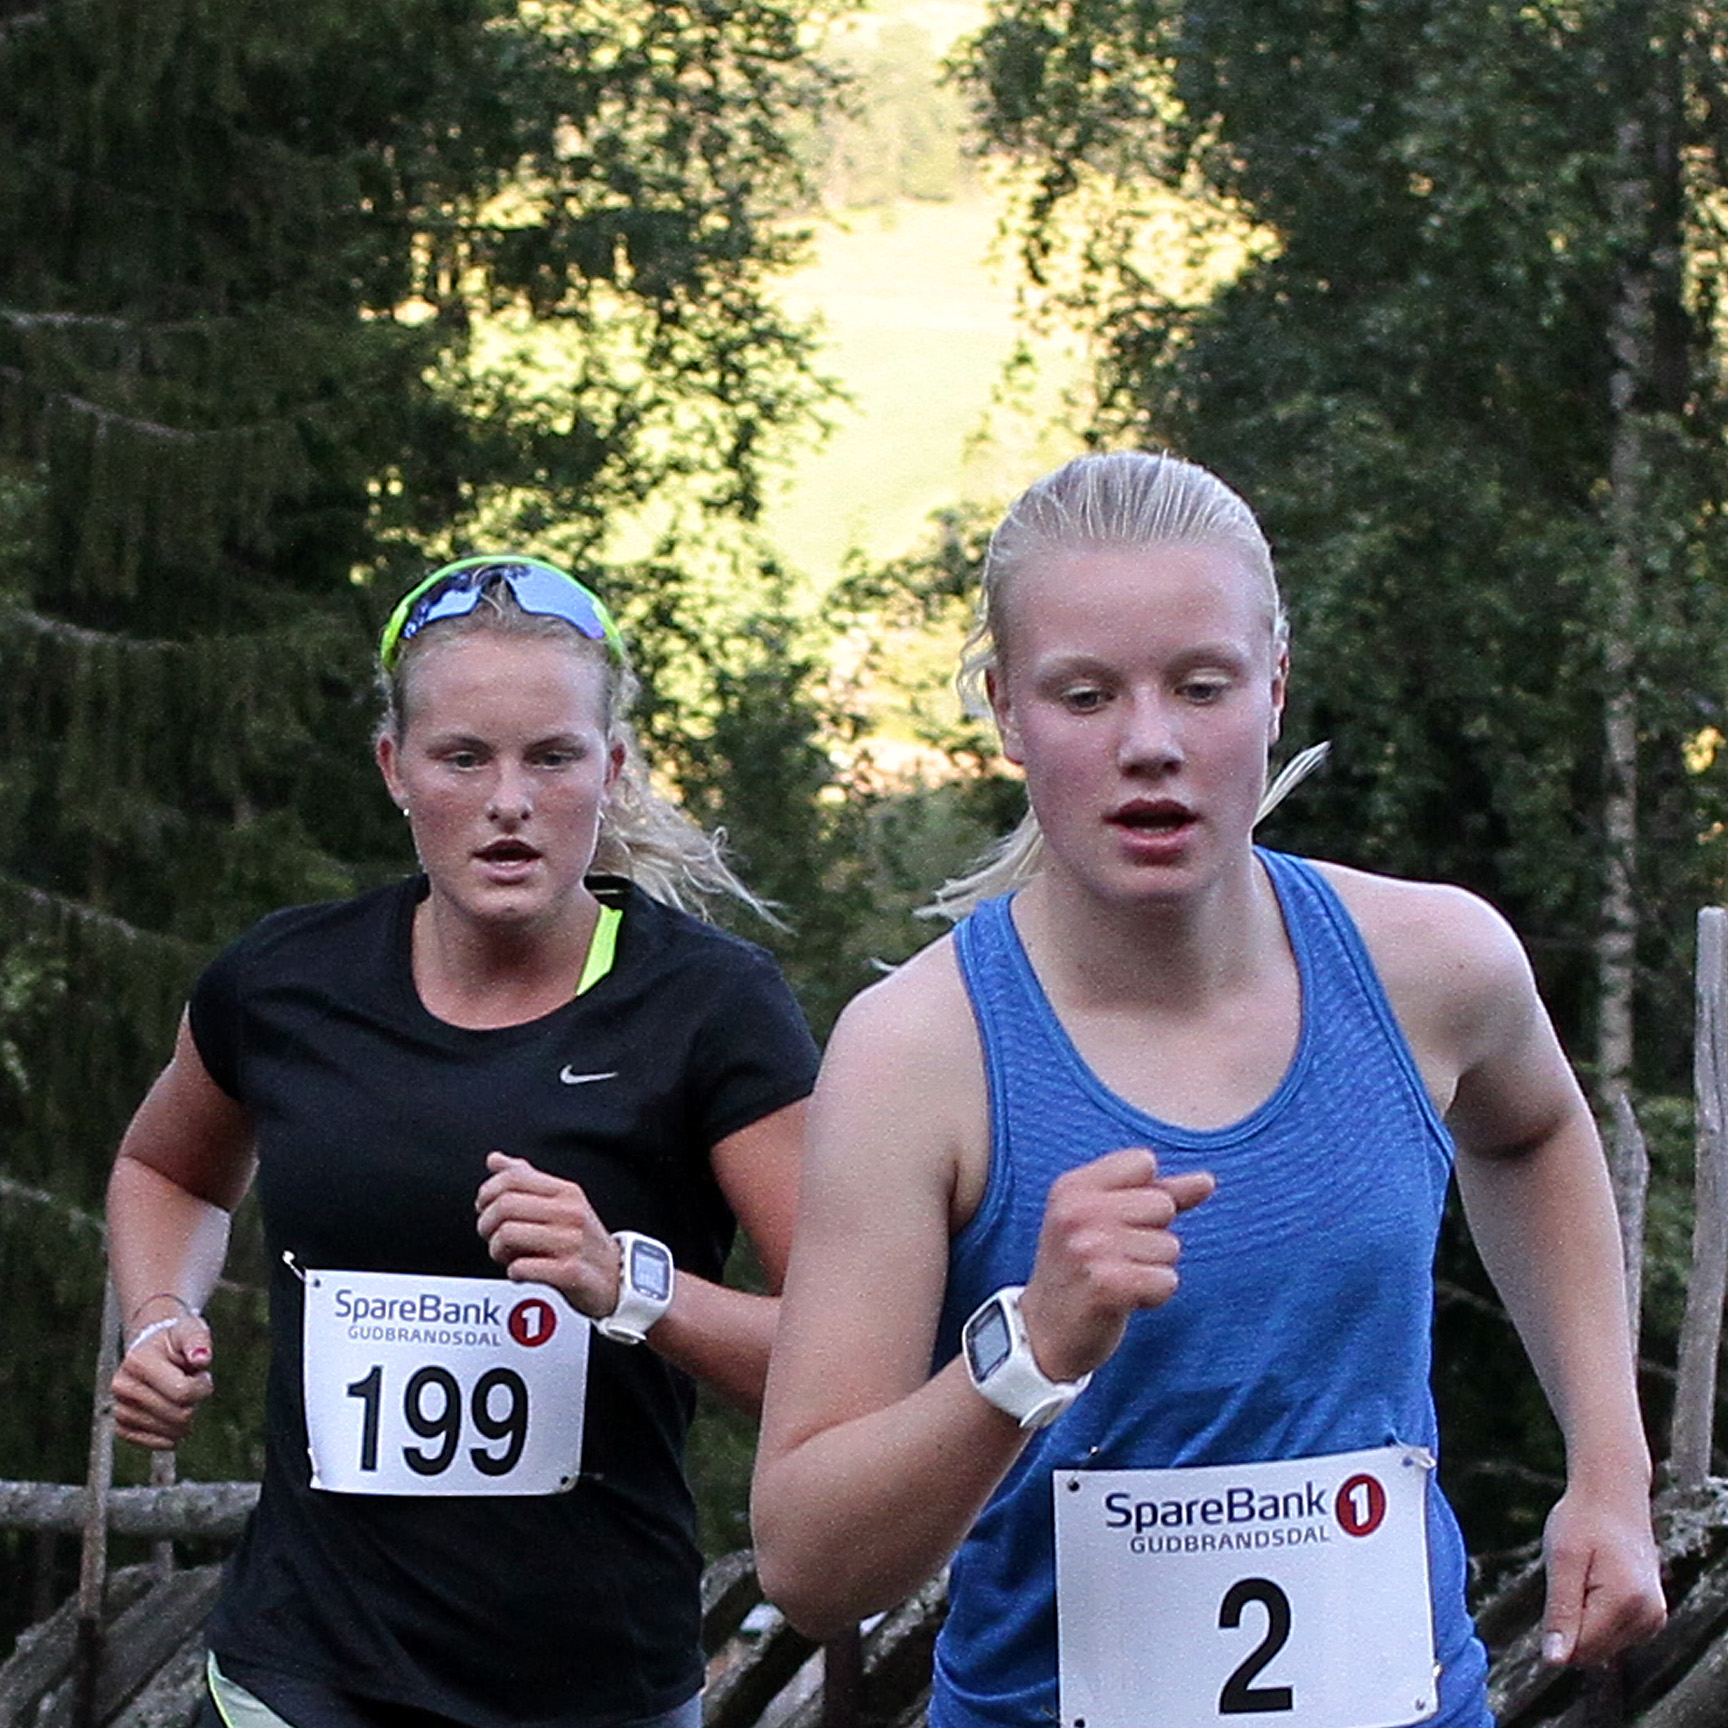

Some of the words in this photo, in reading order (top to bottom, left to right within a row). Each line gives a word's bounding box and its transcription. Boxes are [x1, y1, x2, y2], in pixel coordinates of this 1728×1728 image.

[334, 1289, 501, 1326] SpareBank
[348, 1325, 502, 1347] GUDBRANDSDAL
[346, 1365, 529, 1477] 199
[1104, 1481, 1328, 1533] SpareBank
[1129, 1525, 1330, 1554] GUDBRANDSDAL
[1217, 1577, 1294, 1715] 2
